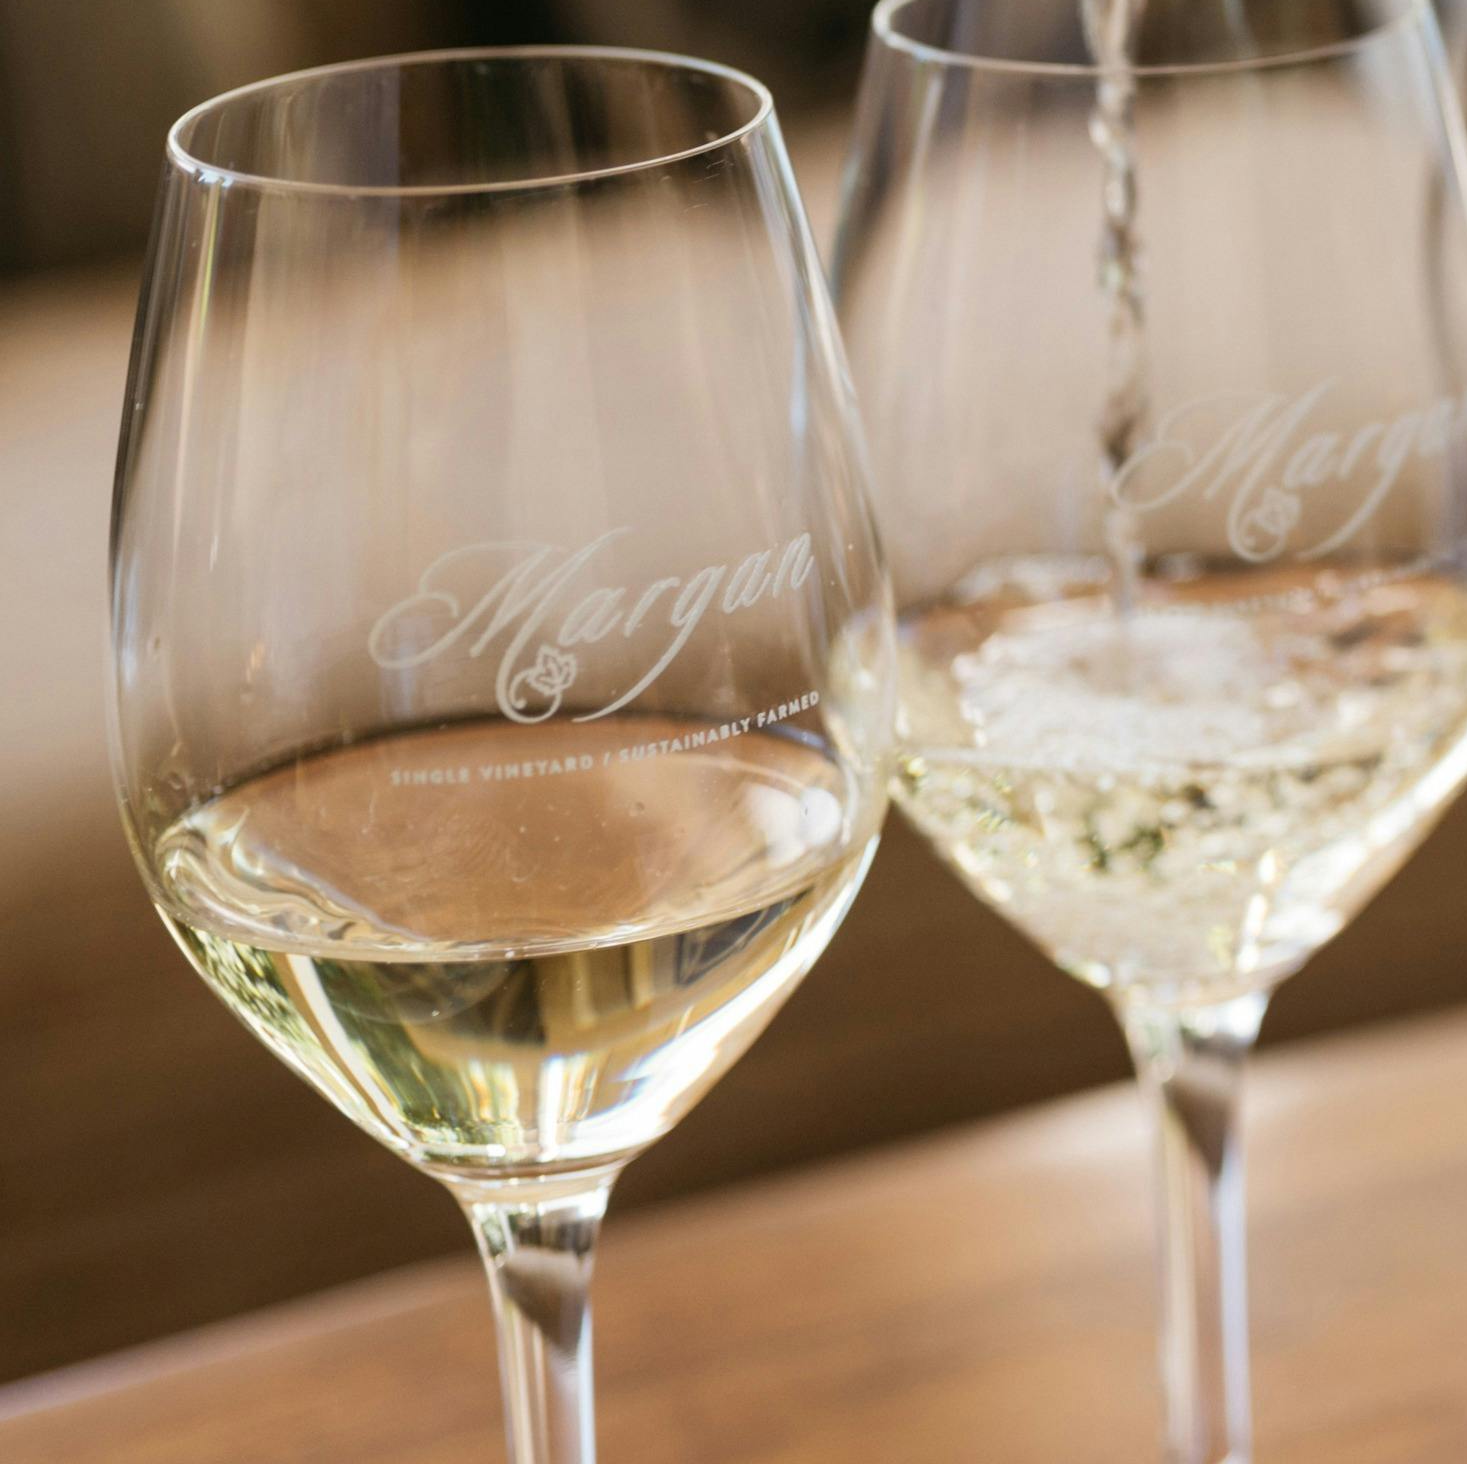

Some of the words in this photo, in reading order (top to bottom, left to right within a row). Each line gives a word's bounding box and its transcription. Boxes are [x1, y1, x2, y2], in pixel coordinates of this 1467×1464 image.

[369, 526, 814, 724] Margan
[390, 766, 470, 786] SINGLE
[482, 754, 594, 782] VINEYARD
[618, 718, 751, 762] SUSTAINABLY
[756, 690, 820, 728] FARMED
